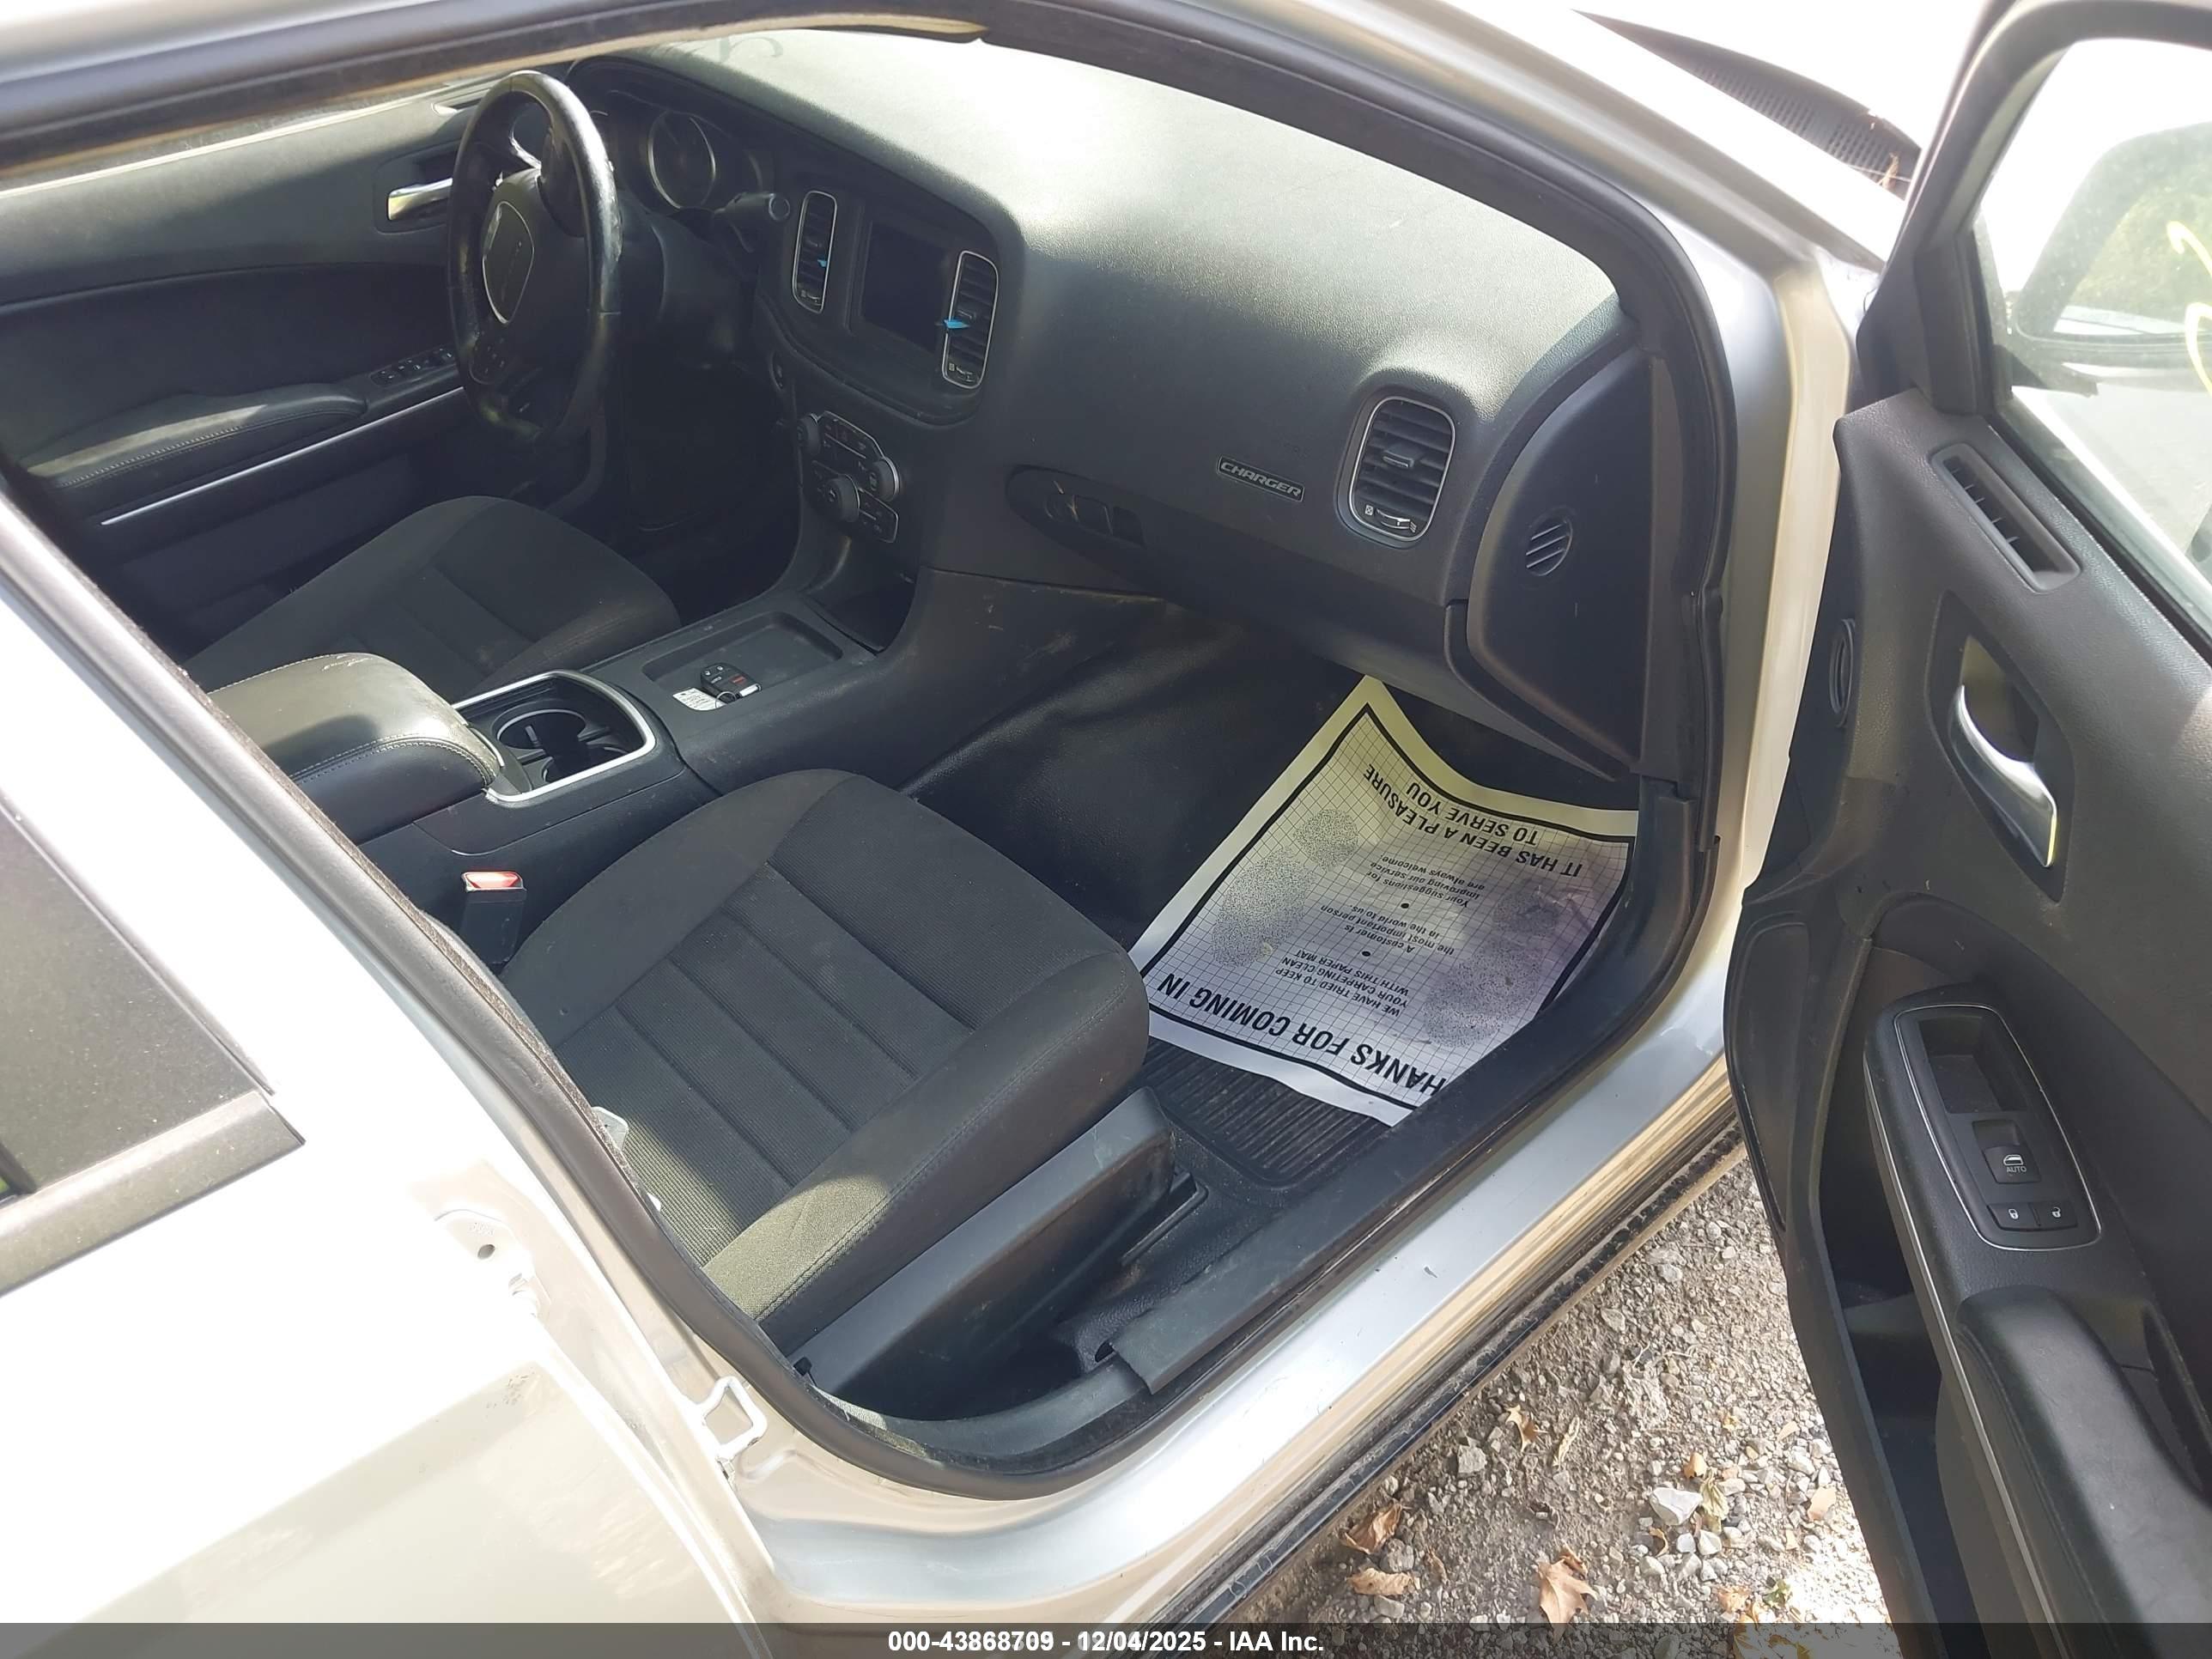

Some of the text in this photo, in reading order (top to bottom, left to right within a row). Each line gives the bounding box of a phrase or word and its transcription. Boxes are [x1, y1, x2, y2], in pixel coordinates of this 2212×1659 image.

[1220, 462, 1302, 496] CHARGER
[1363, 763, 1583, 877] IT HAS BEEN A PLEASURE
[1406, 782, 1538, 846] TO SERVE YOU
[1370, 862, 1407, 879] service
[1380, 855, 1426, 873] welcome.
[1429, 870, 1465, 885] always
[1366, 872, 1468, 908] Your suggestions for
[1427, 879, 1480, 900] improving
[1350, 905, 1364, 915] us.
[1377, 915, 1407, 929] world
[1320, 905, 1455, 955] the most important person
[1344, 924, 1354, 933] is
[1354, 929, 1404, 948] customer
[1409, 924, 1426, 934] the
[1282, 957, 1407, 1007] YOUR CARPETING CLEAN
[1294, 950, 1408, 996] WITH THIS PAPER MAT
[1275, 969, 1400, 1017] WE HAVE TRIED TO KEEP
[1158, 973, 1446, 1096] HANKS FOR COMING IN
